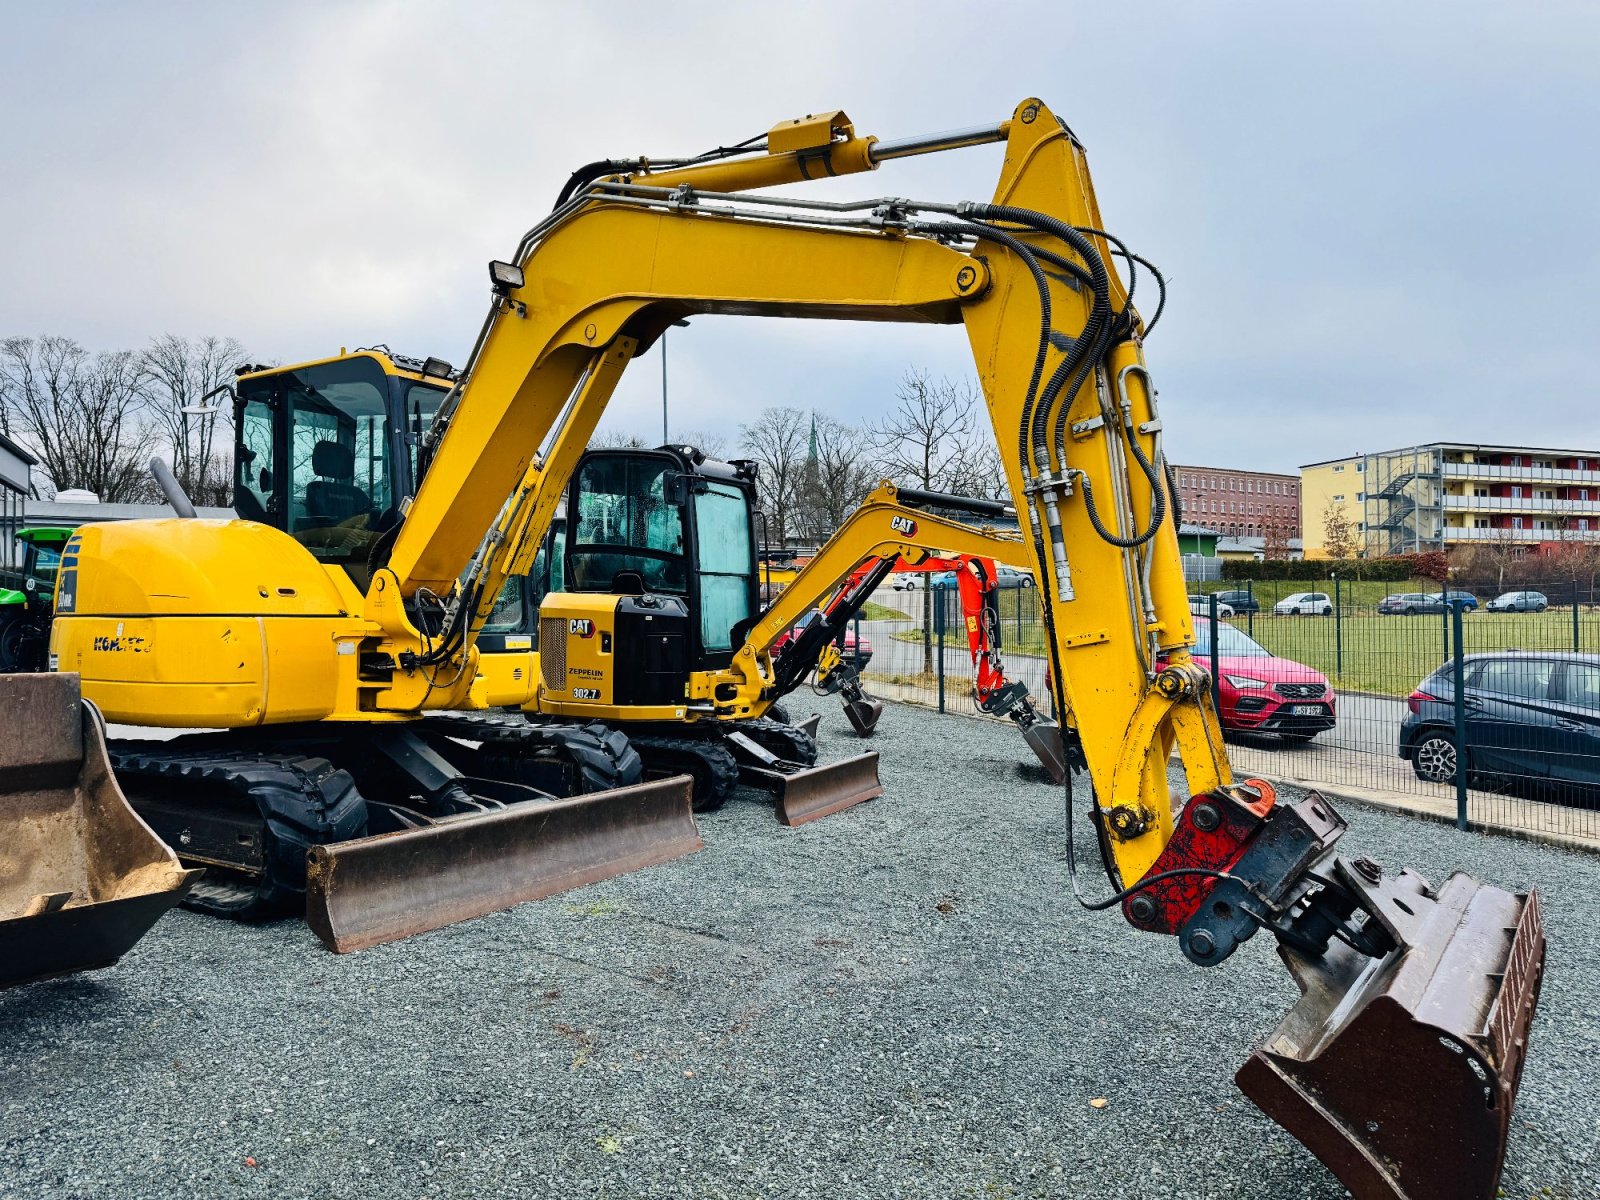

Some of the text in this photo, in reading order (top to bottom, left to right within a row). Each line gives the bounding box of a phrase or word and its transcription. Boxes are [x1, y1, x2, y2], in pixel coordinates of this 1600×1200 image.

[891, 515, 914, 533] CAT
[569, 619, 590, 634] CAT
[568, 667, 604, 677] ZEPPELIN
[573, 687, 597, 699] 302.7
